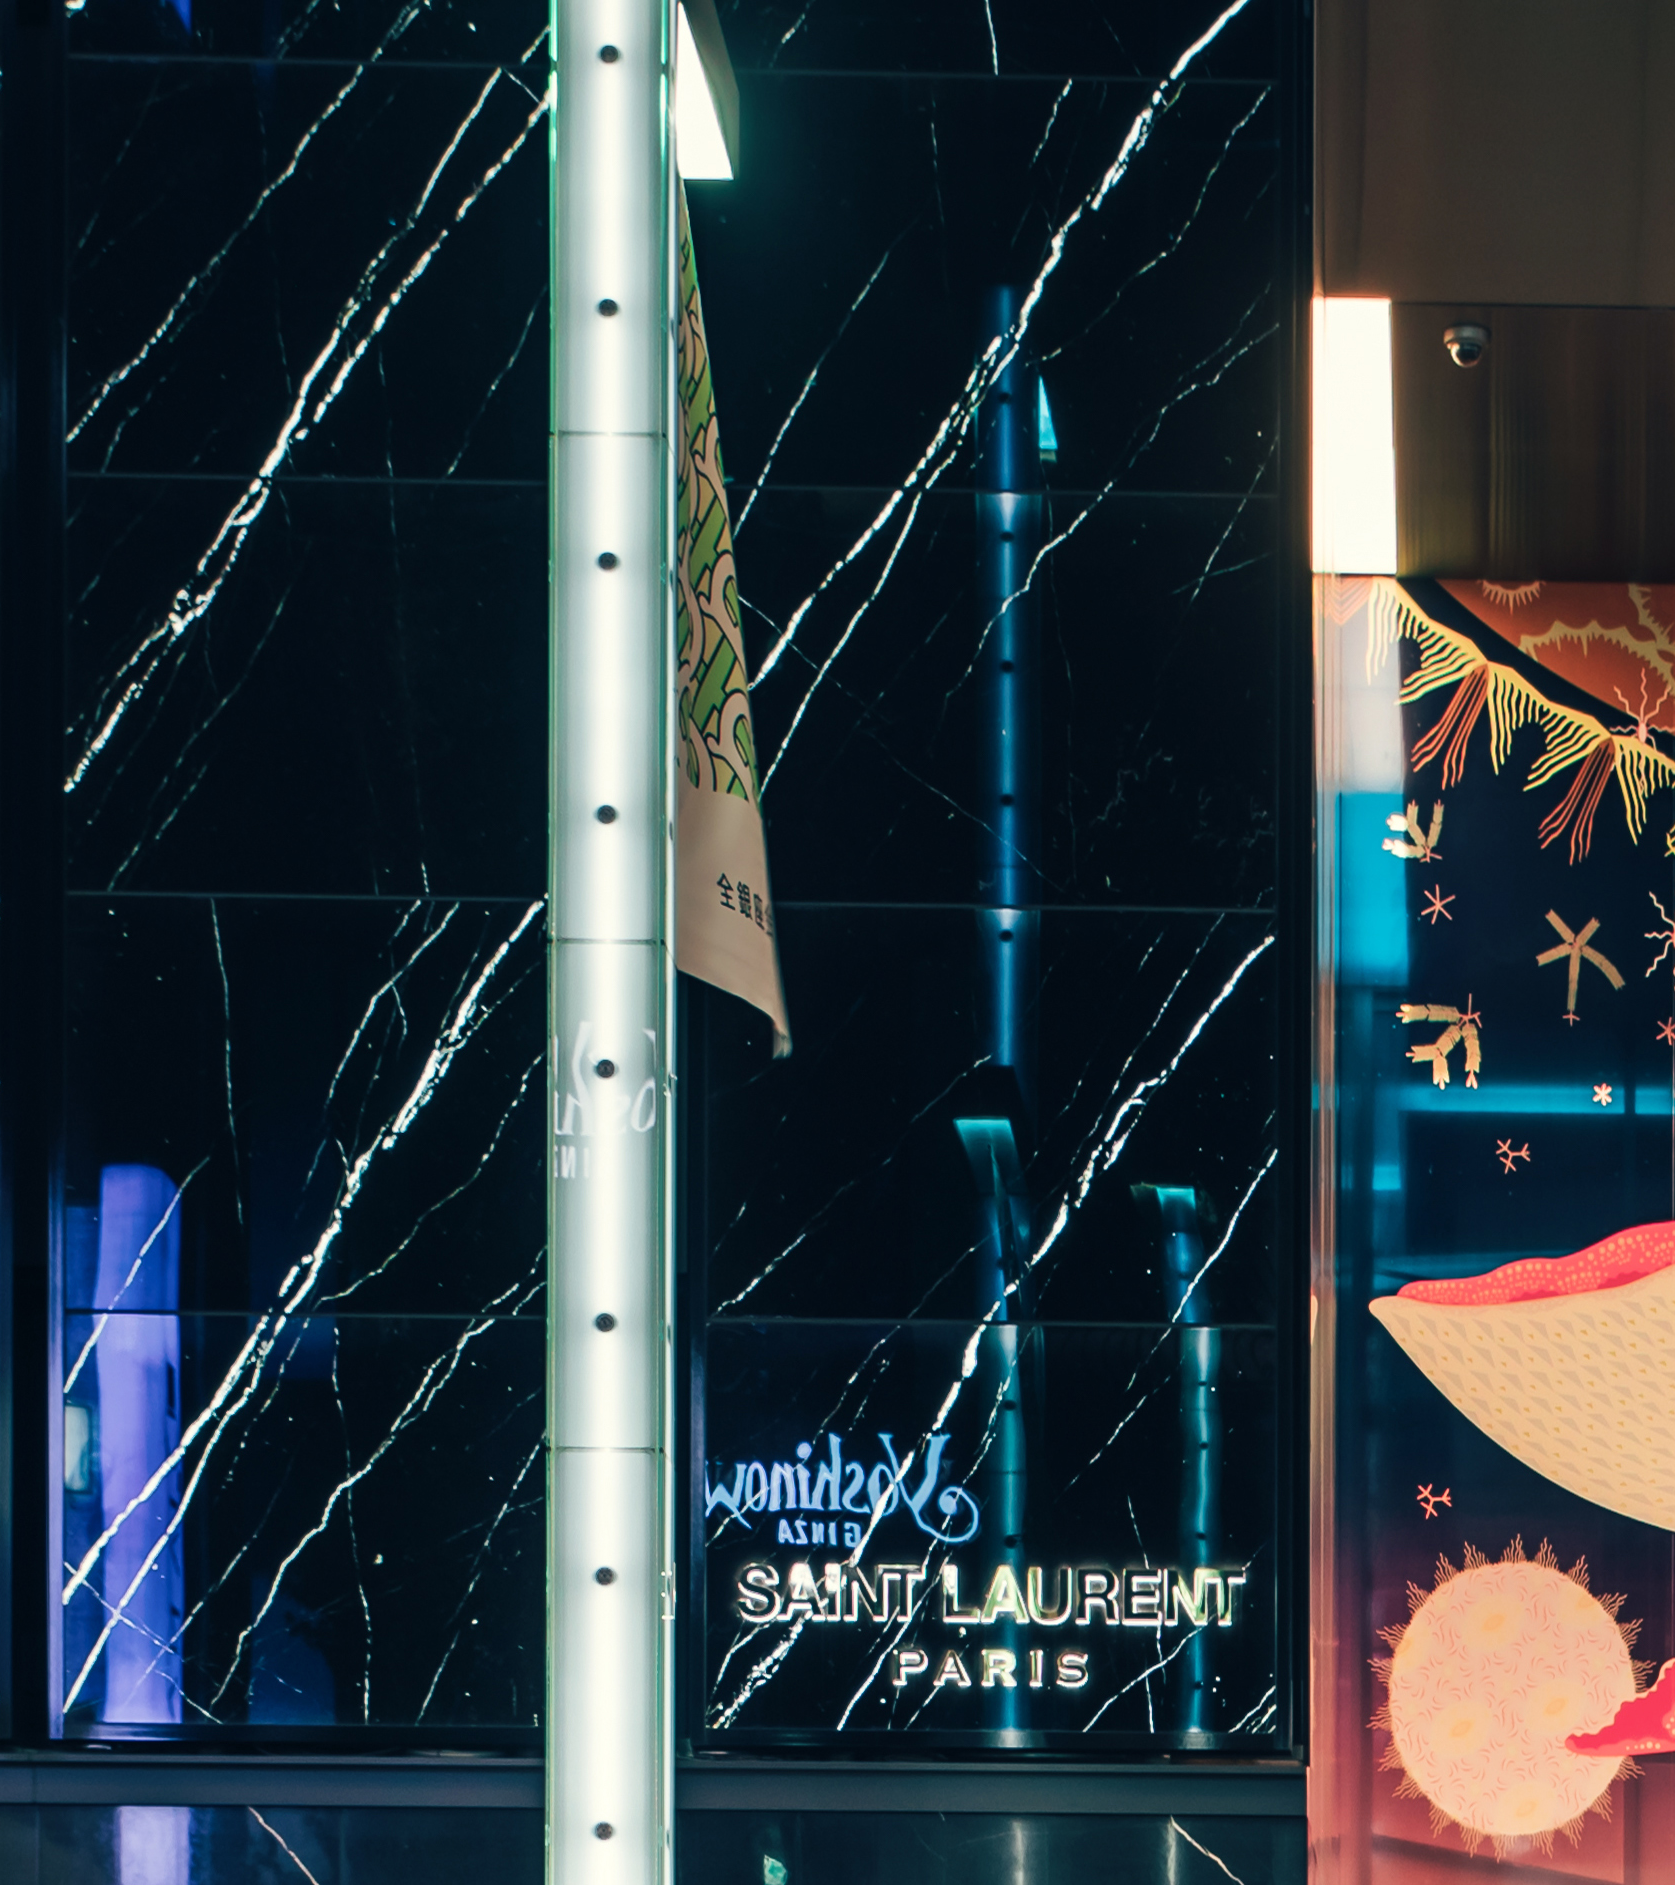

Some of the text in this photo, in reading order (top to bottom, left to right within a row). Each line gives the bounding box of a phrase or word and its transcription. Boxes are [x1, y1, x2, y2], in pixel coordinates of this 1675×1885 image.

[736, 1562, 1247, 1627] SAINT LAURENT
[892, 1649, 1090, 1688] PARIS
